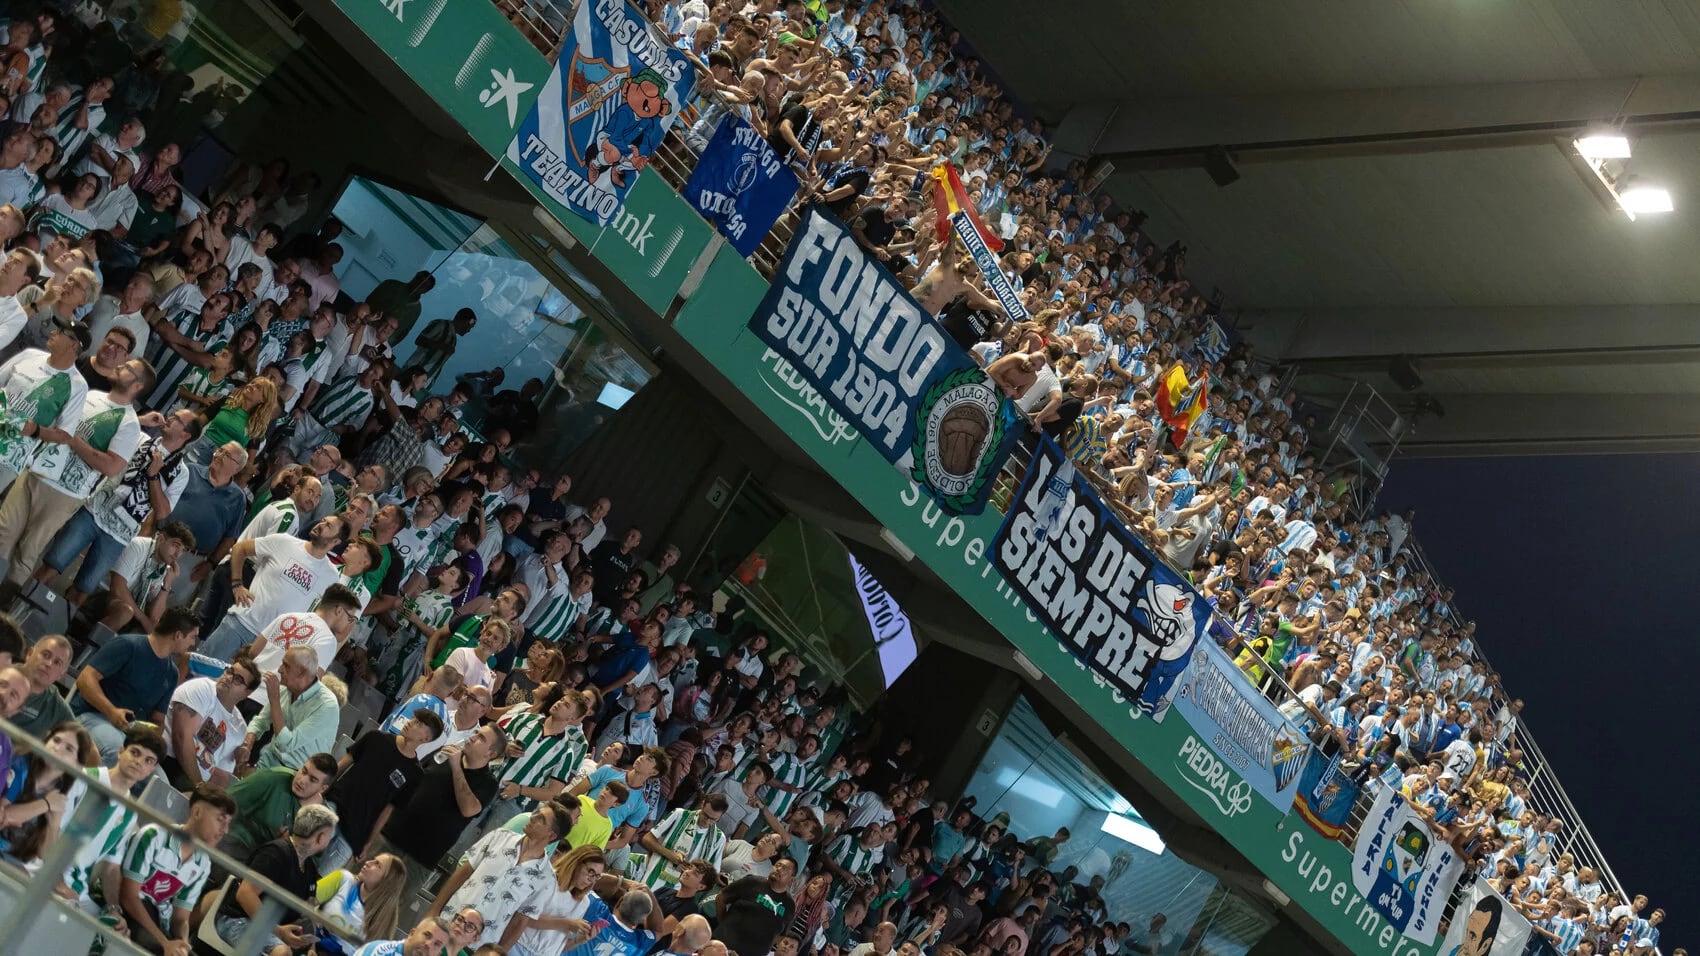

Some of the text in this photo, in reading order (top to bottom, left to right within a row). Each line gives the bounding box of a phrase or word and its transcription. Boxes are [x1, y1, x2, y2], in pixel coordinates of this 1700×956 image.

[595, 0, 688, 82] CASUALS
[519, 133, 619, 220] TEATINO
[786, 210, 946, 397] FONDO
[766, 286, 909, 449] SUR 1904
[282, 568, 312, 592] LONDON
[1001, 511, 1161, 691] SIEMPRE
[1086, 530, 1147, 615] DE
[981, 719, 991, 732] 3
[1361, 792, 1404, 876] MALAKA
[1414, 851, 1452, 931] HINCHAS
